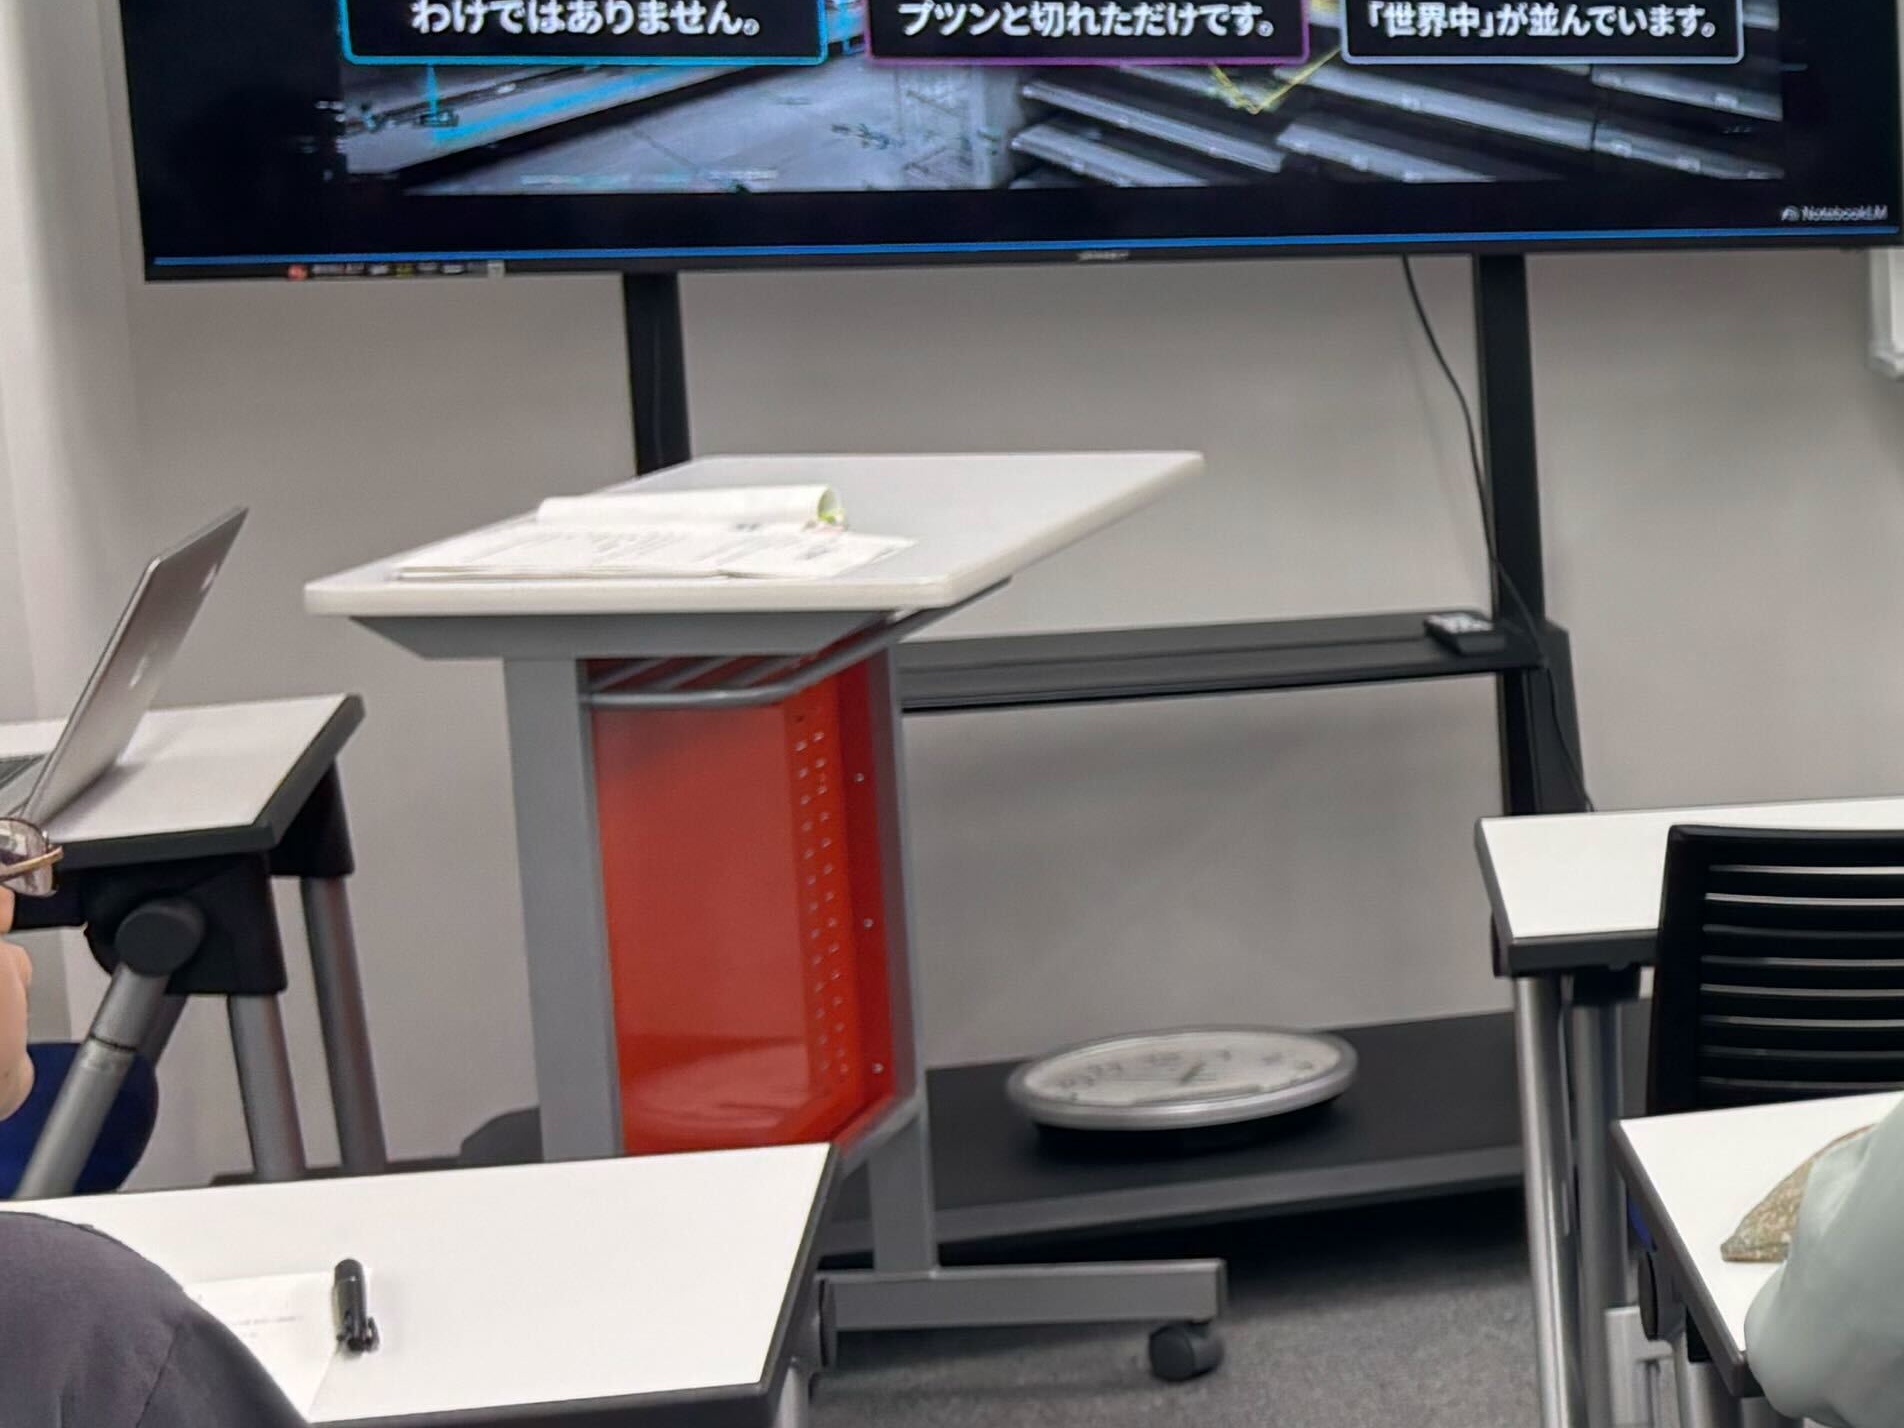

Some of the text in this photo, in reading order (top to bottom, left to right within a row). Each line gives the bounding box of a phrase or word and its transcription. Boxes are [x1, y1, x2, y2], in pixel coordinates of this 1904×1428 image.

[1367, 2, 1717, 40] 「世界中」が並んでいます。
